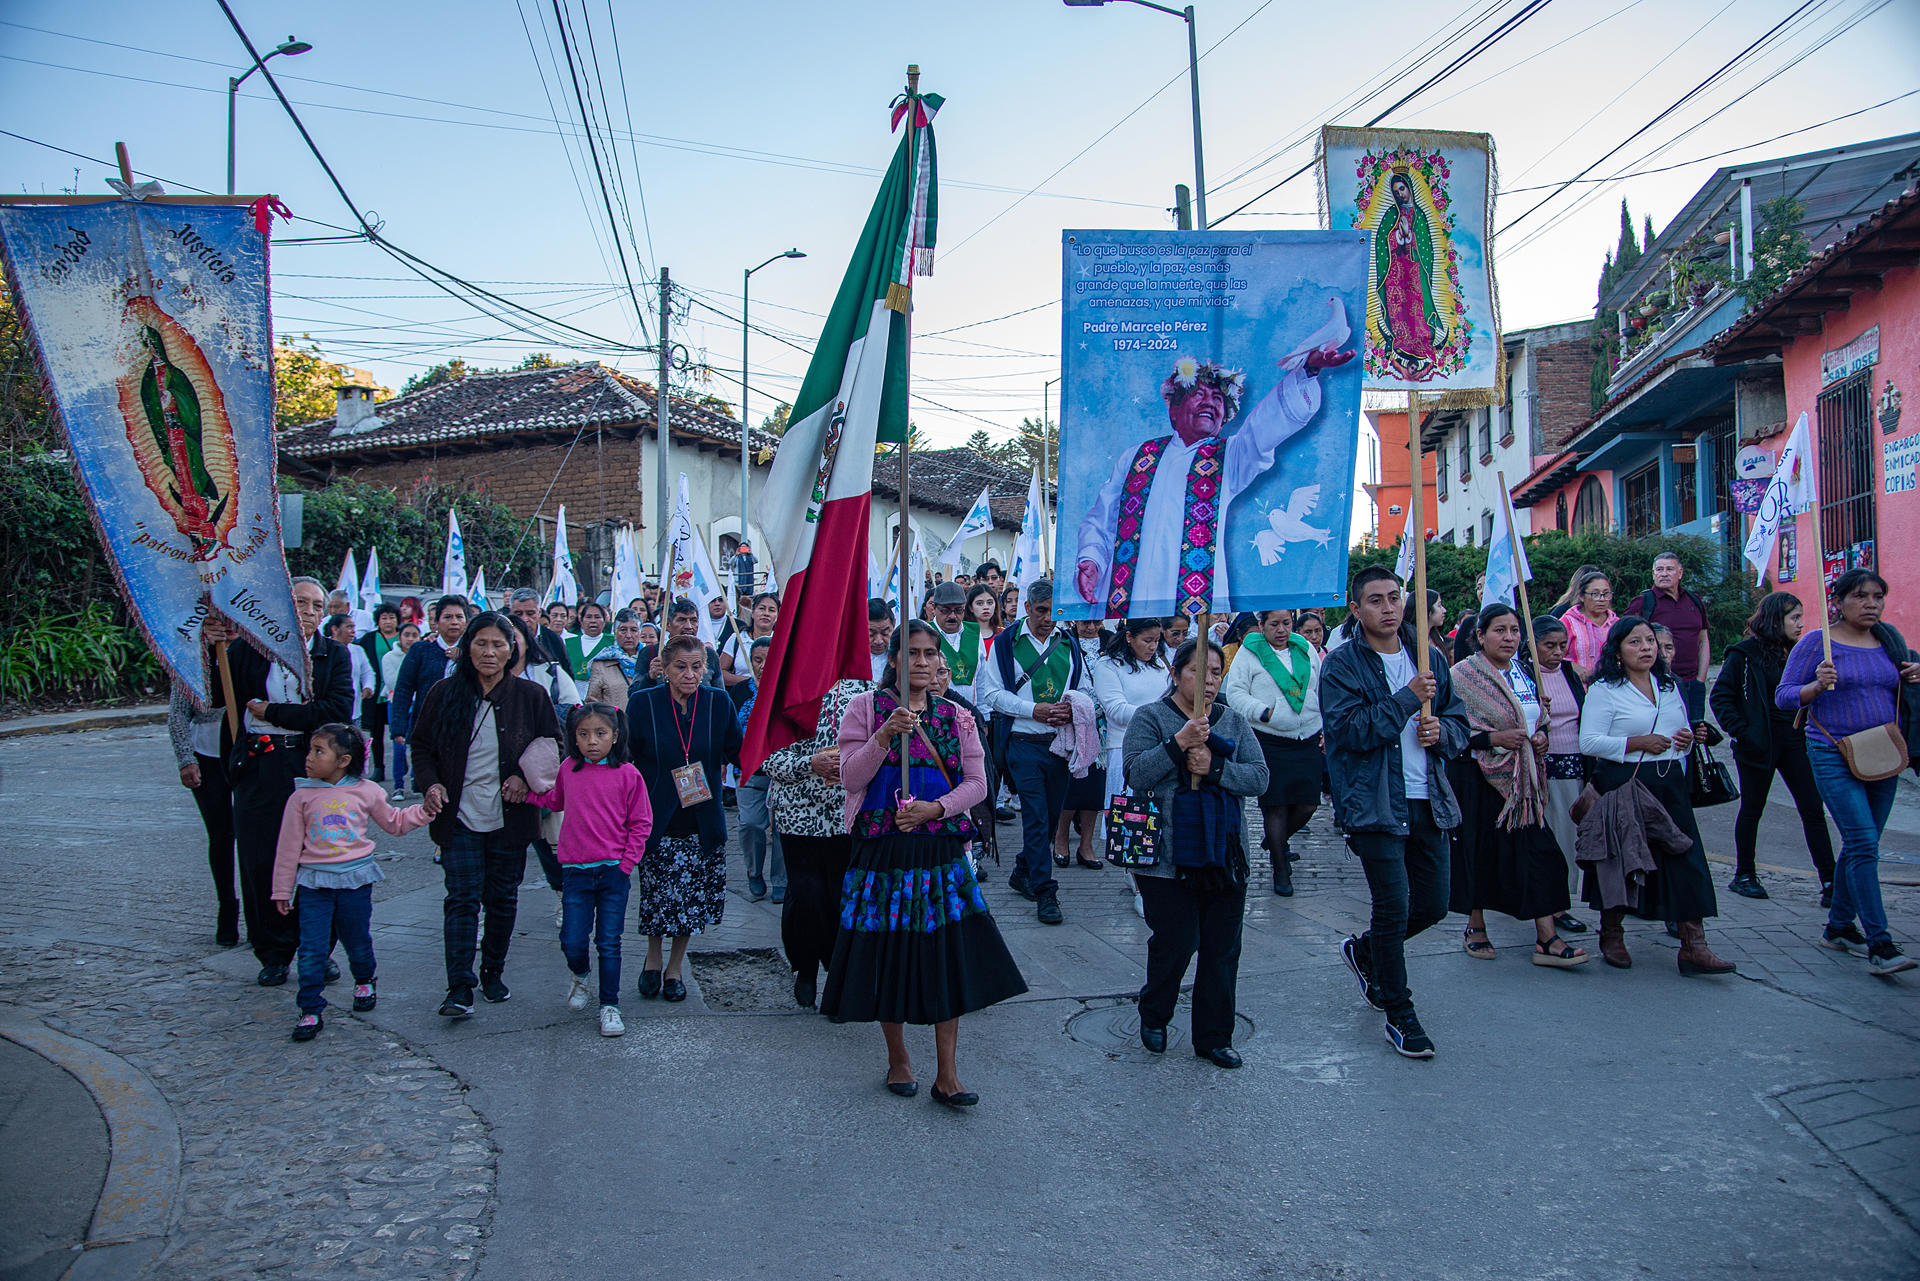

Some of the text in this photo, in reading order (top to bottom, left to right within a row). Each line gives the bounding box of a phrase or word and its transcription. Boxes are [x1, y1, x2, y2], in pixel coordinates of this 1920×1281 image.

[168, 223, 237, 285] Justicia
[1094, 246, 1117, 259] que
[1120, 243, 1156, 256] busco
[1158, 246, 1172, 256] es
[1174, 244, 1186, 256] la
[1187, 246, 1210, 259] paz
[1210, 246, 1239, 259] para
[1240, 244, 1253, 256] el
[1094, 260, 1230, 276] pueblo, y la paz, es más
[1076, 278, 1248, 294] grande que la muerte, que las
[1089, 298, 1152, 308] amenazas,
[1154, 298, 1162, 310] y
[1163, 297, 1186, 310] que
[1188, 296, 1203, 307] mi
[1083, 319, 1208, 333] Padre Marcelo Pérez
[1113, 339, 1178, 351] 1974-2024
[1829, 365, 1848, 381] SAN
[1743, 456, 1766, 467] LALA
[1885, 472, 1915, 493] COPIAS
